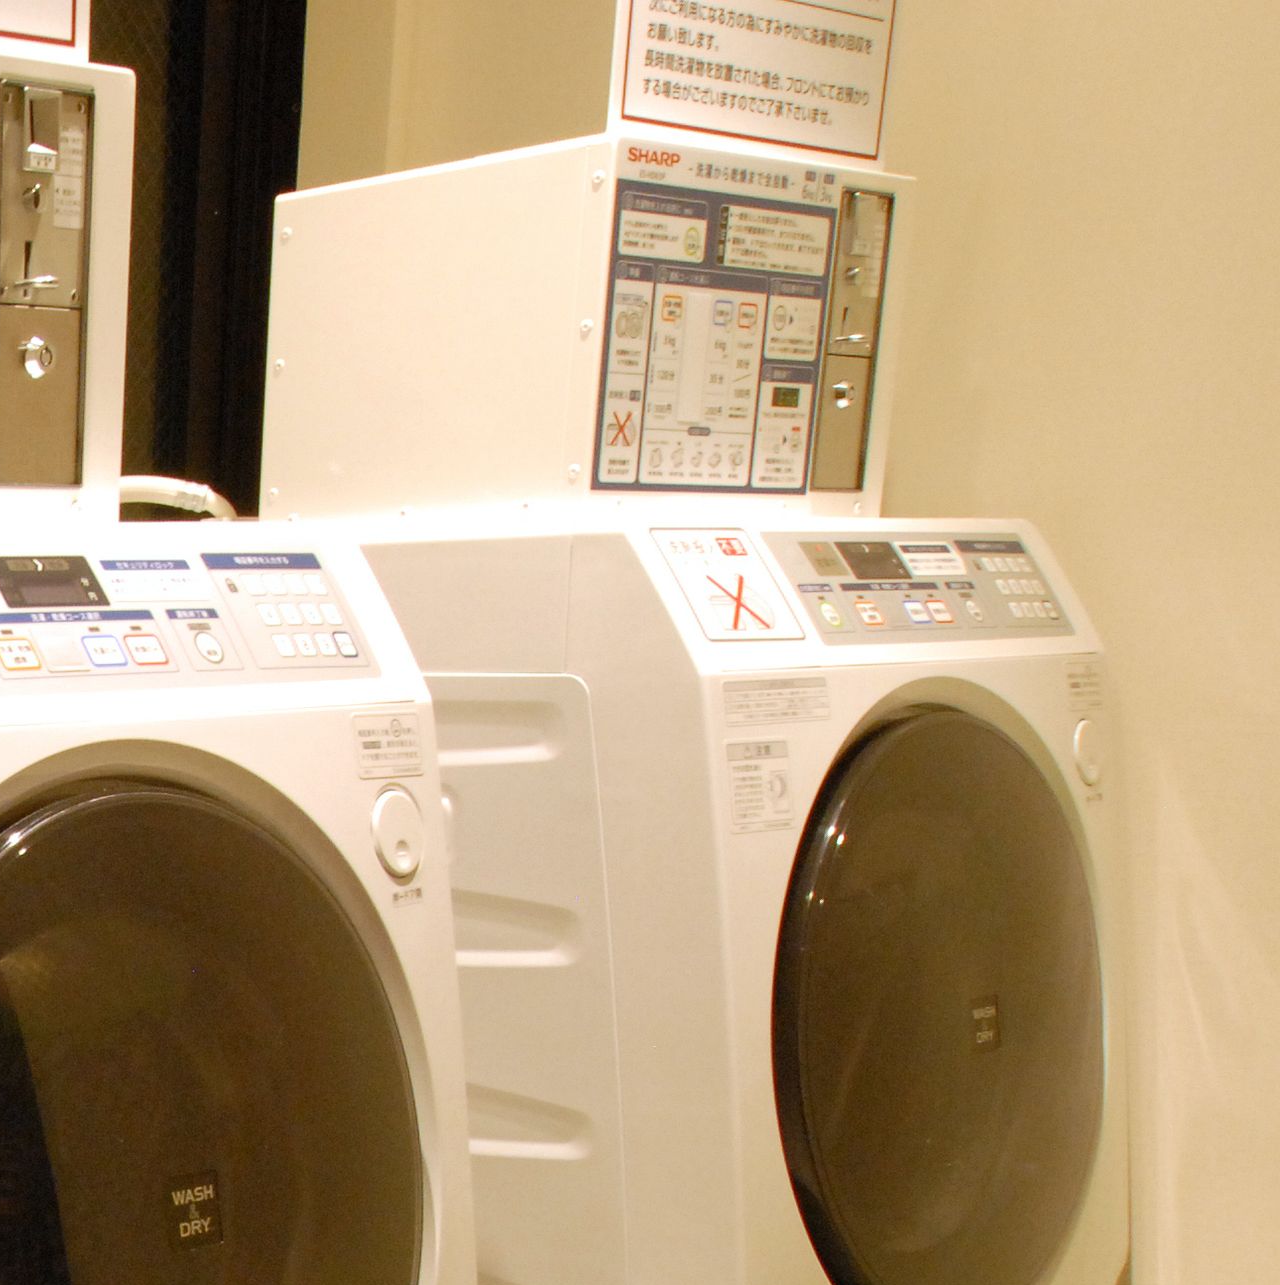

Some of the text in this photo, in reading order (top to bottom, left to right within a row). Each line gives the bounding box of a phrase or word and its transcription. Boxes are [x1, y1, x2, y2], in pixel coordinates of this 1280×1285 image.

[627, 147, 681, 167] SHARP
[171, 1184, 214, 1206] WASH
[179, 1217, 212, 1238] DRY
